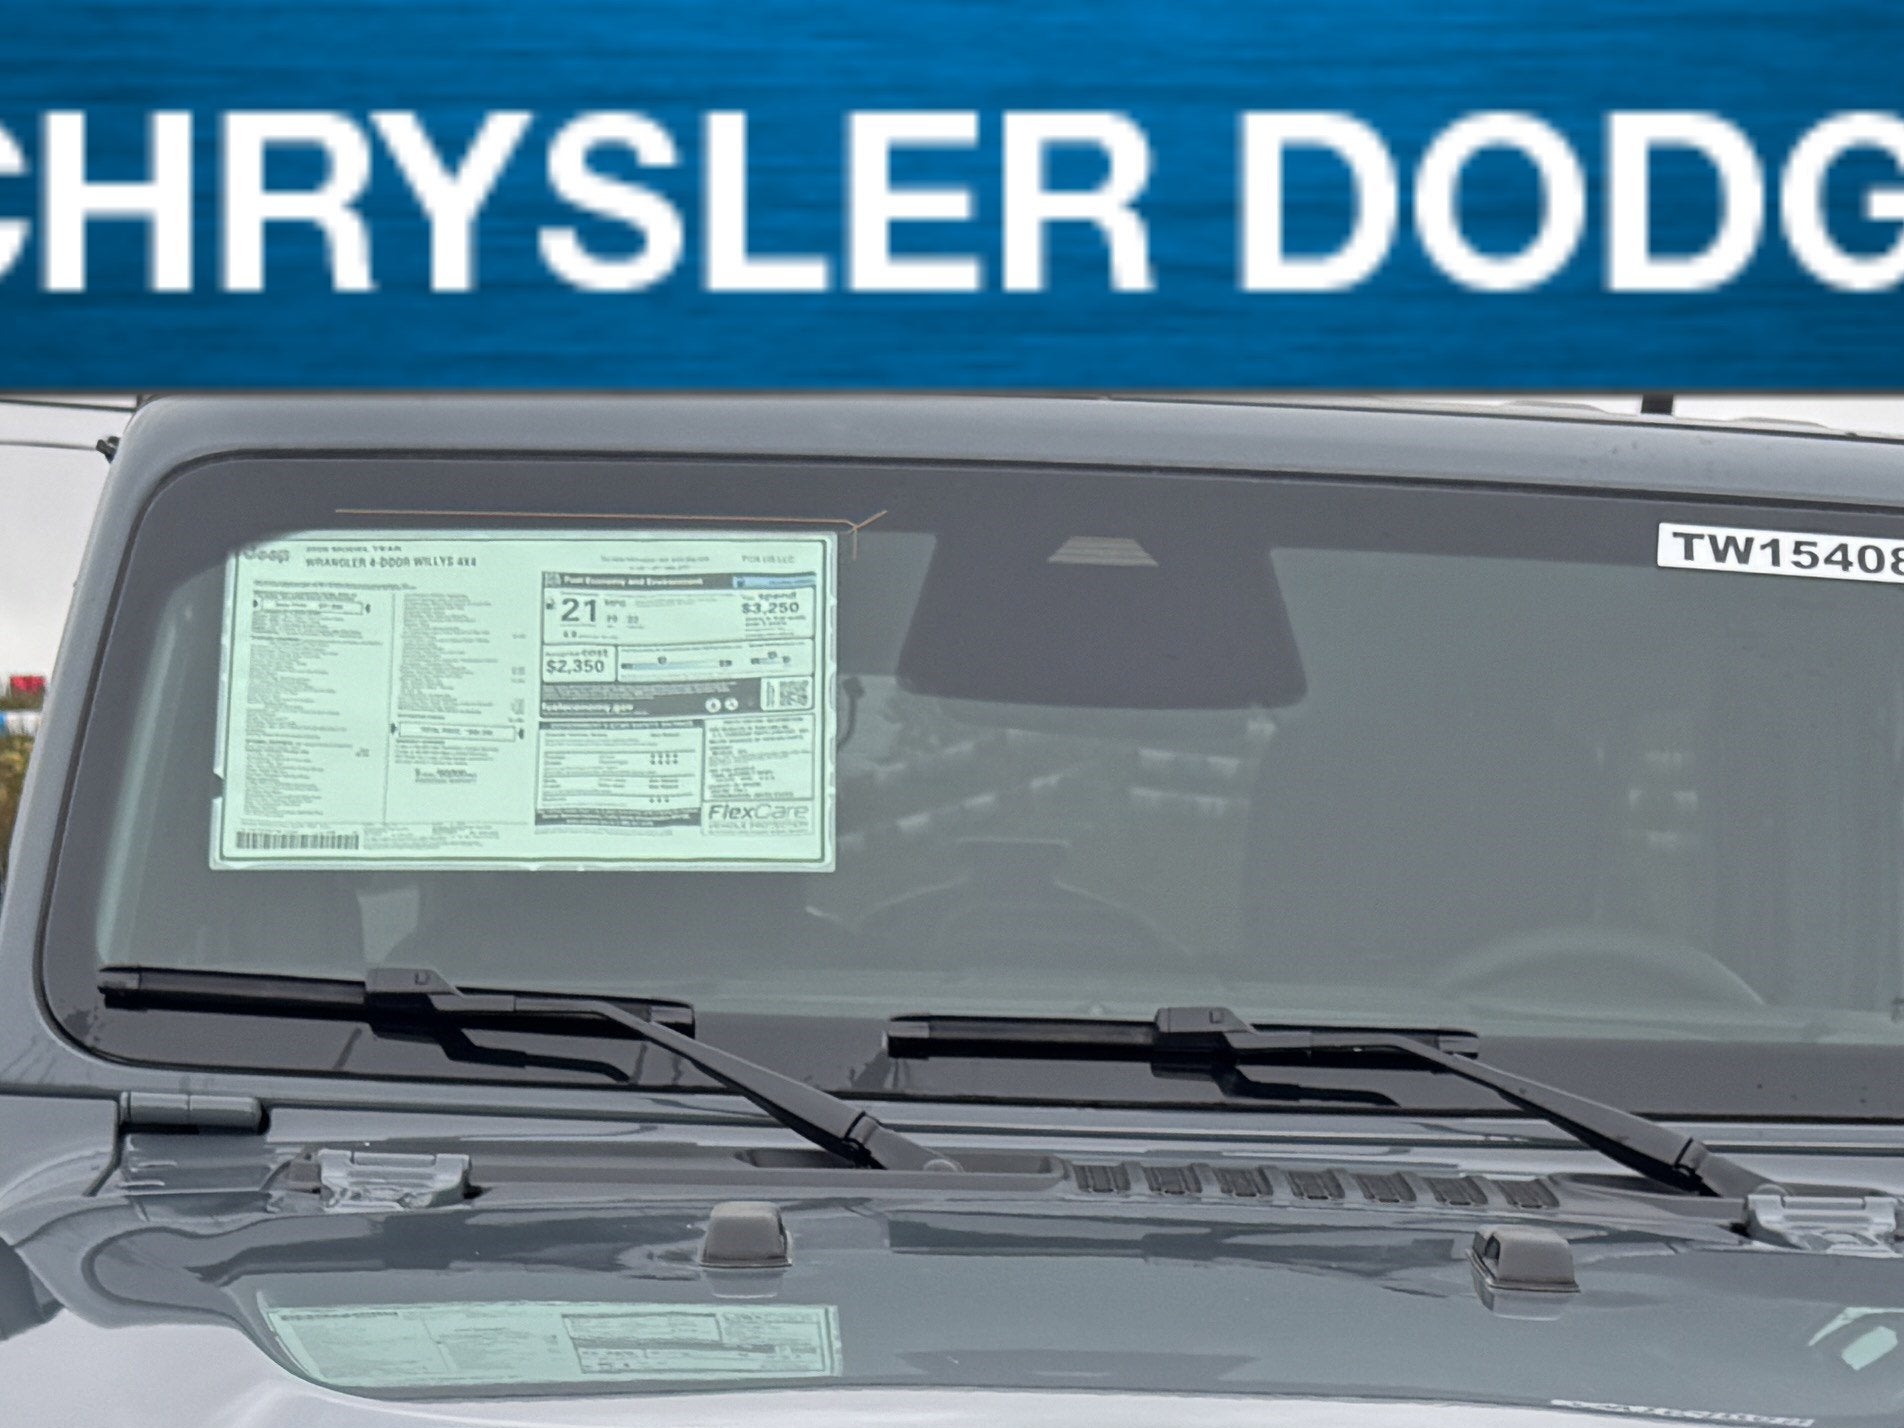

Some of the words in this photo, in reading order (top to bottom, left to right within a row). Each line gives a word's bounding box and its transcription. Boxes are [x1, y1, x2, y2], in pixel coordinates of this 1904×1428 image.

[305, 556, 367, 568] WRANGLER
[414, 556, 454, 568] WILLYS
[560, 597, 597, 623] 21
[741, 601, 800, 617] $3,250
[546, 658, 605, 675] $2,350
[707, 803, 810, 821] FlexCare
